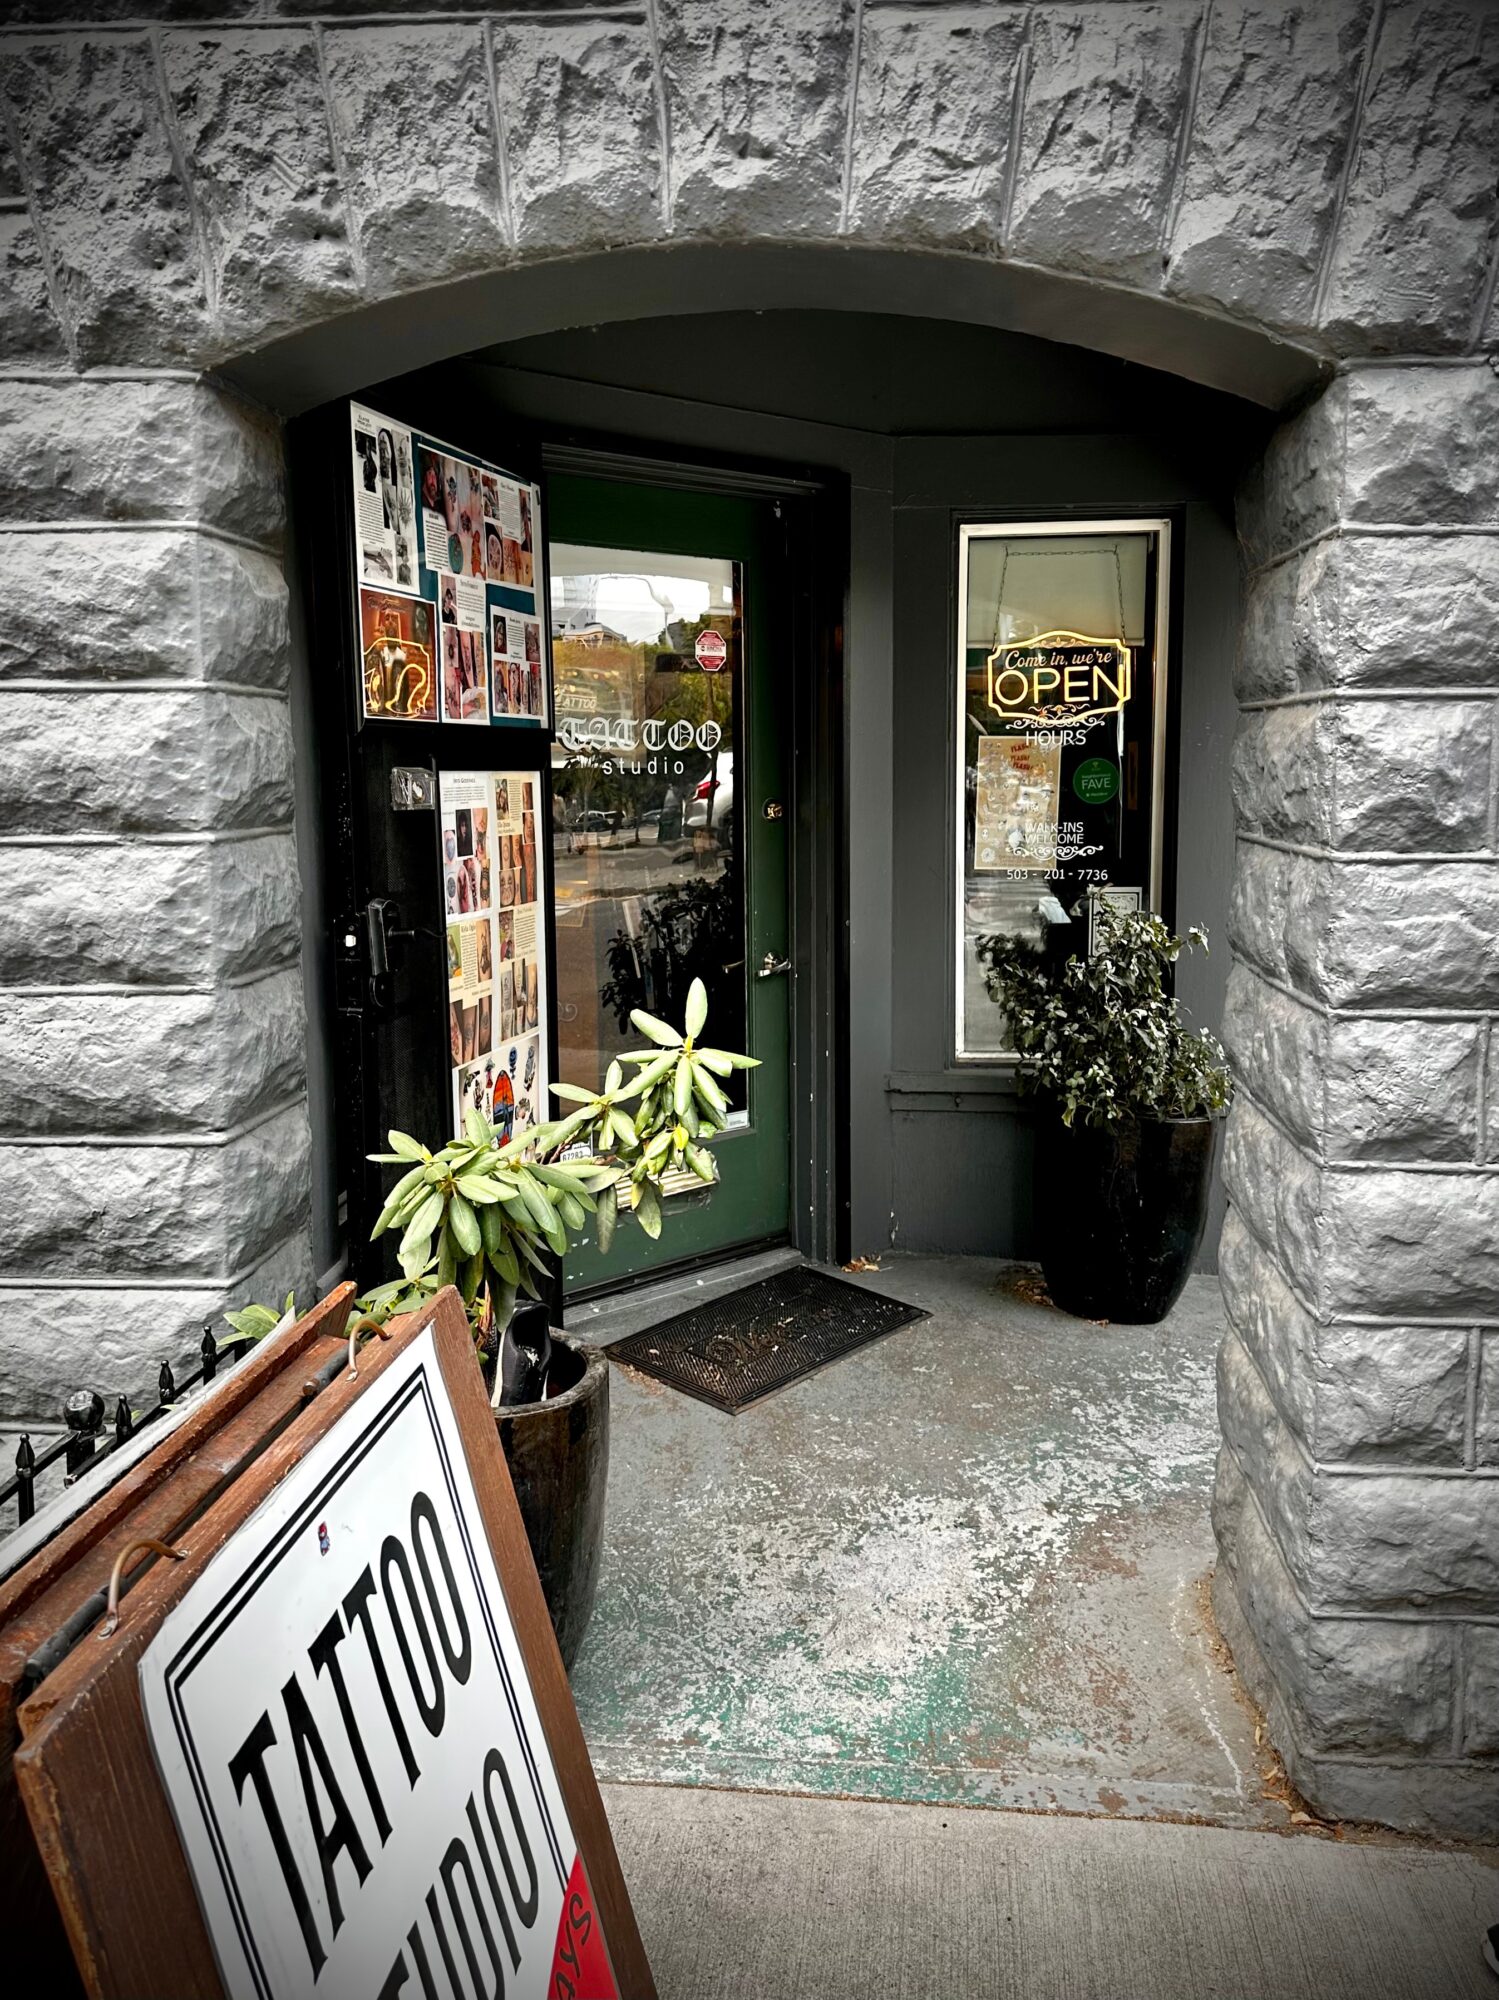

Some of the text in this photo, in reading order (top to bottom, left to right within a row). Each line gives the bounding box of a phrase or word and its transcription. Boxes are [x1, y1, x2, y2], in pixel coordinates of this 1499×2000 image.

[1005, 648, 1113, 670] Come in, we're
[995, 665, 1124, 705] OPEN
[560, 716, 722, 752] TATTOO
[1025, 729, 1087, 746] HOURS
[603, 757, 685, 775] studio
[1081, 777, 1112, 790] FAVE
[1024, 821, 1084, 833] WALK-INS
[1024, 833, 1084, 845] WELCOME
[1006, 869, 1028, 880] 503
[1044, 868, 1065, 880] 201
[1077, 869, 1109, 881] 7736
[227, 1491, 473, 1984] TATTOO
[376, 1747, 539, 2000] UDIO
